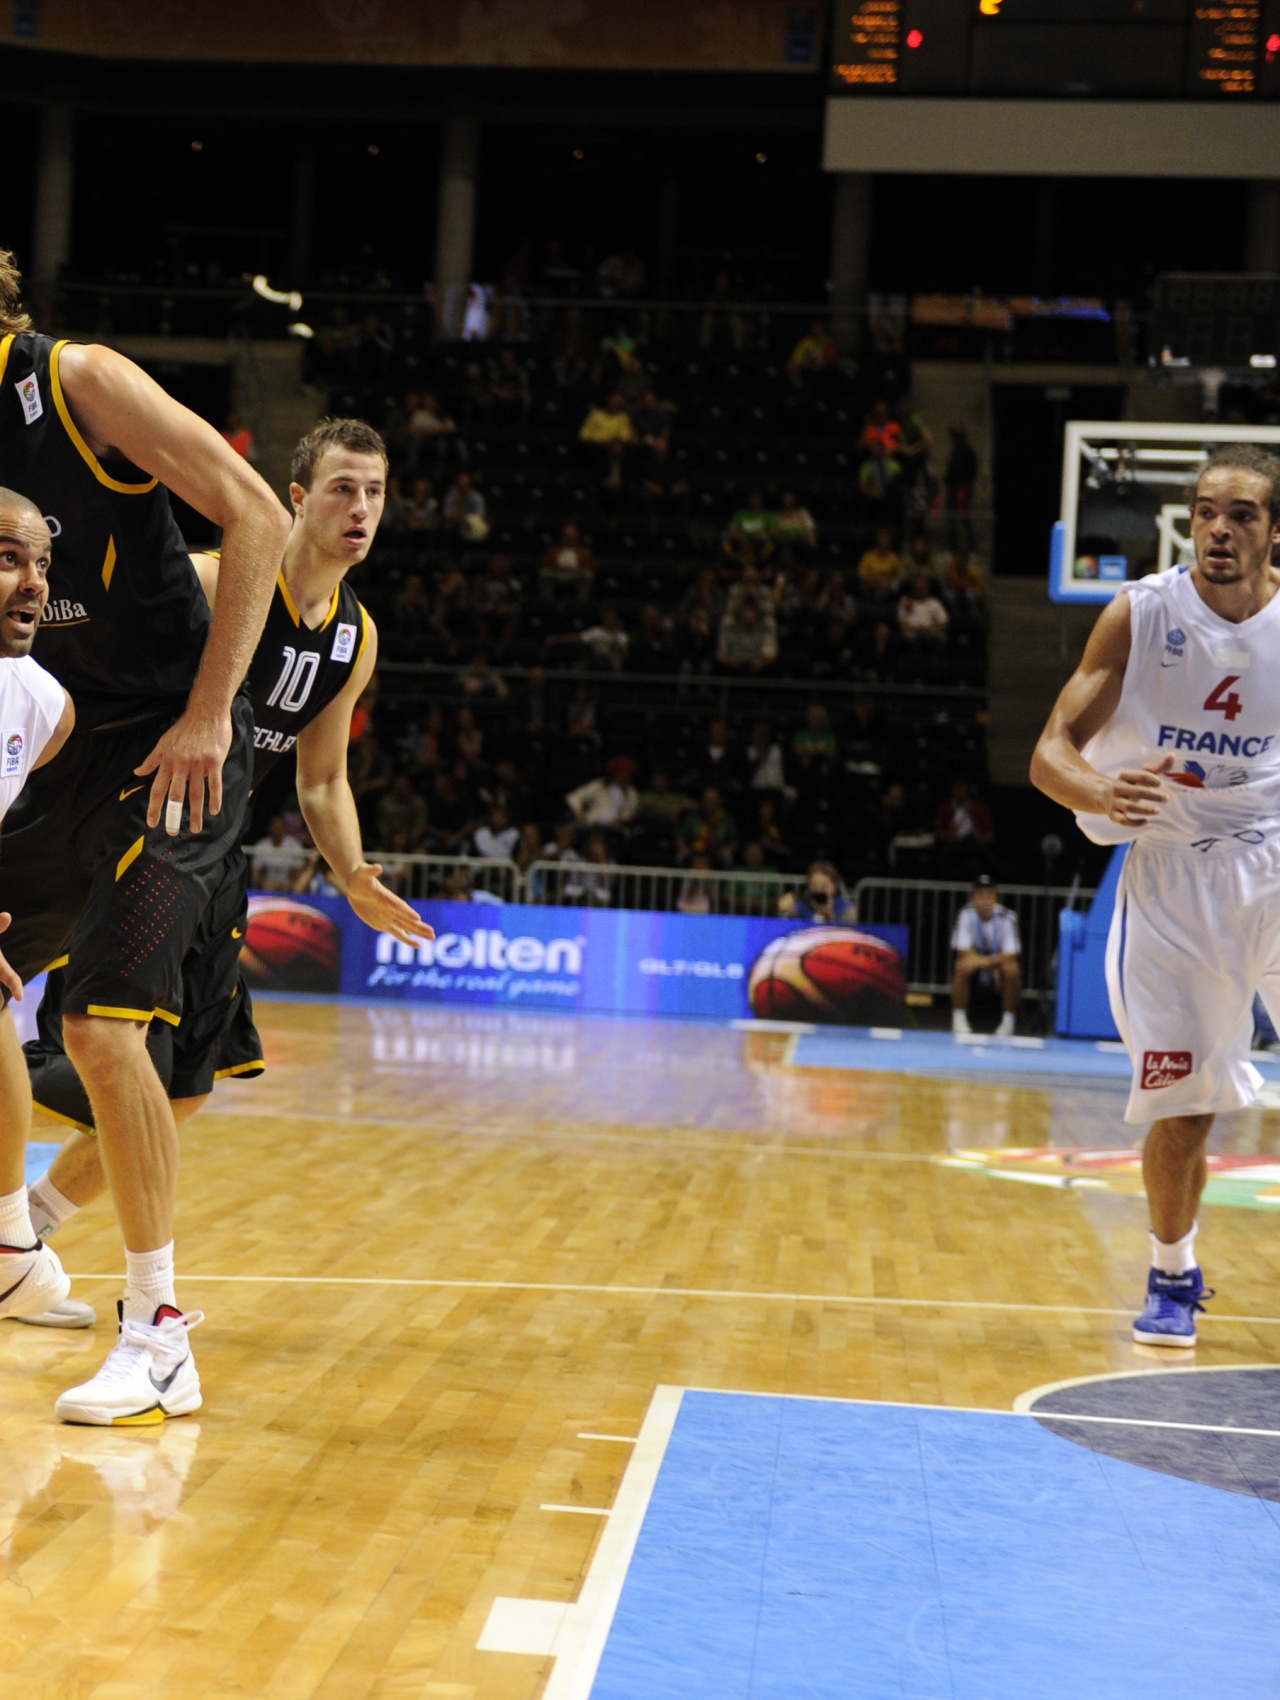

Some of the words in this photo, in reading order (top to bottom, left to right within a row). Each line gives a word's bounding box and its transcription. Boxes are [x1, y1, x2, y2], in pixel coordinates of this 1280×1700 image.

[266, 645, 320, 712] 10
[1203, 675, 1242, 721] 4
[376, 928, 583, 974] molten
